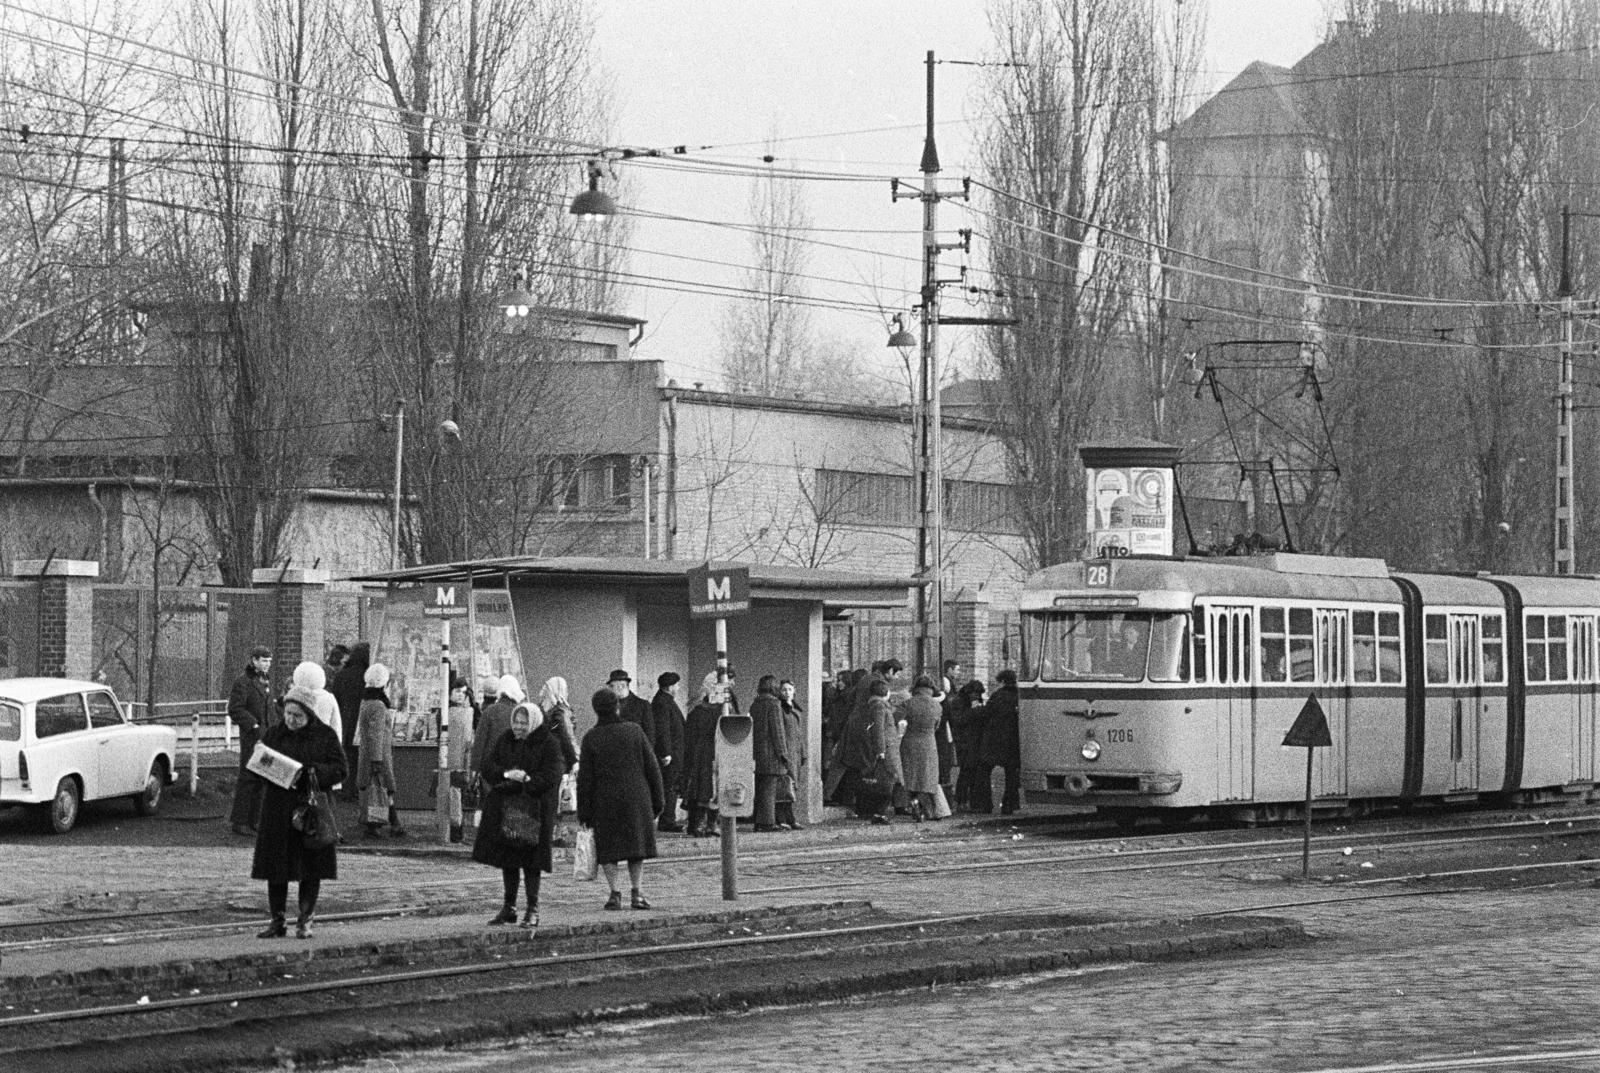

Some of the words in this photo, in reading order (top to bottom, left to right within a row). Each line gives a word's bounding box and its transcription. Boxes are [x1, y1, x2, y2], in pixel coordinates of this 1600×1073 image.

[1088, 566, 1108, 585] 28
[437, 587, 455, 605] M
[707, 576, 731, 600] M
[1108, 729, 1134, 743] 1206
